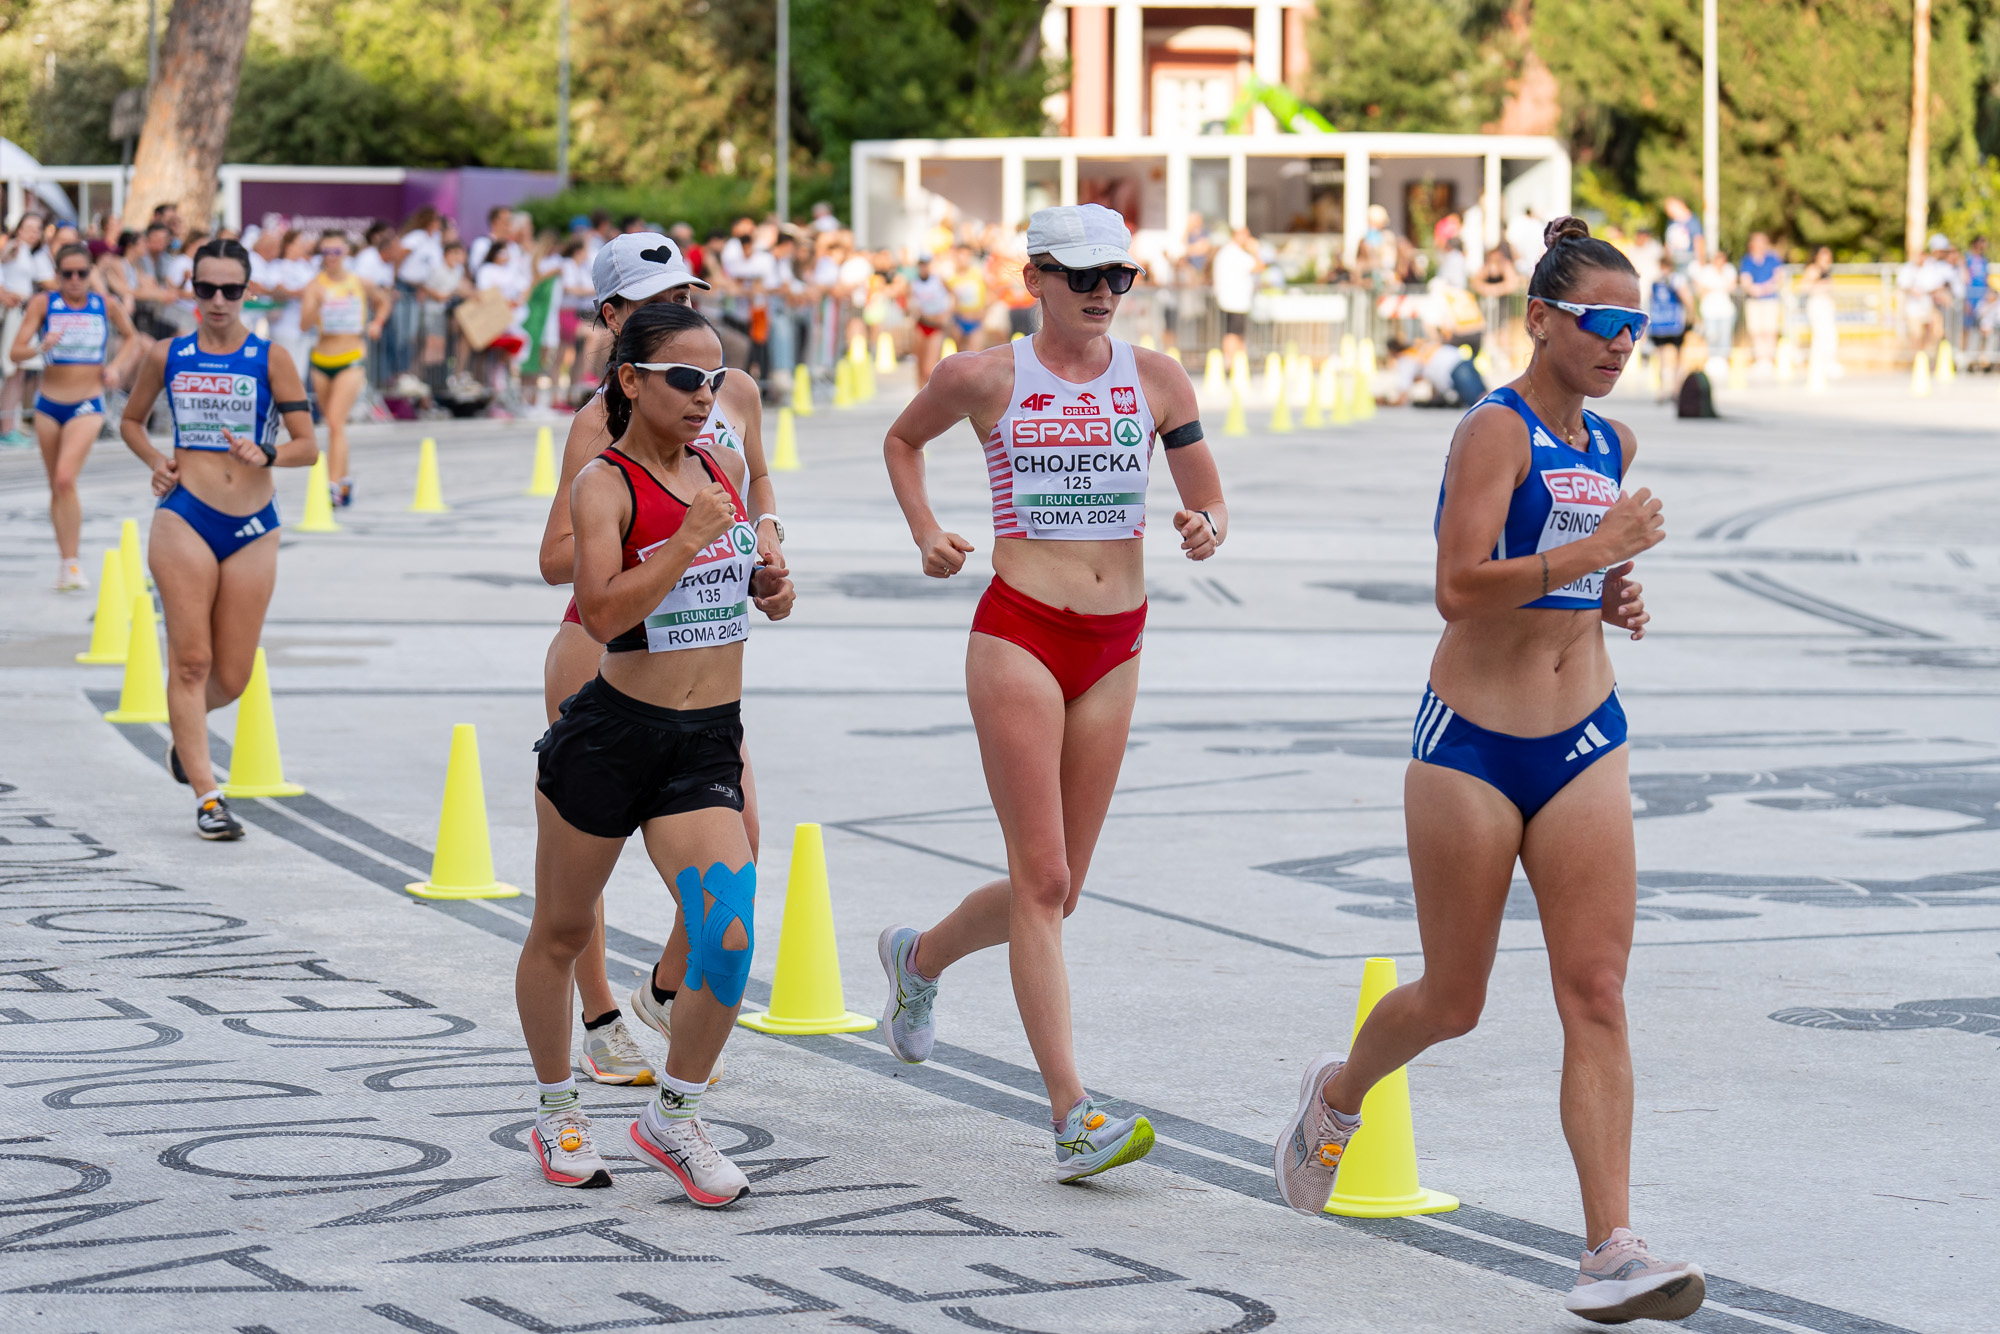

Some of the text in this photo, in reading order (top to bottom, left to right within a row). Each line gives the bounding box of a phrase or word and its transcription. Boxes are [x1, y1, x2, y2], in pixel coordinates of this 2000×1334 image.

[173, 375, 231, 393] SPAR
[1064, 407, 1098, 415] ORLEN
[1015, 421, 1109, 444] SPAR
[1014, 453, 1141, 474] CHOJECKA
[1063, 476, 1092, 490] 125
[1549, 475, 1617, 504] SPAR
[1045, 495, 1073, 505] RUN
[1031, 509, 1127, 526] ROMA 2024
[696, 588, 721, 604] 135
[681, 609, 708, 623] RUN
[668, 620, 743, 645] ROMA 2024
